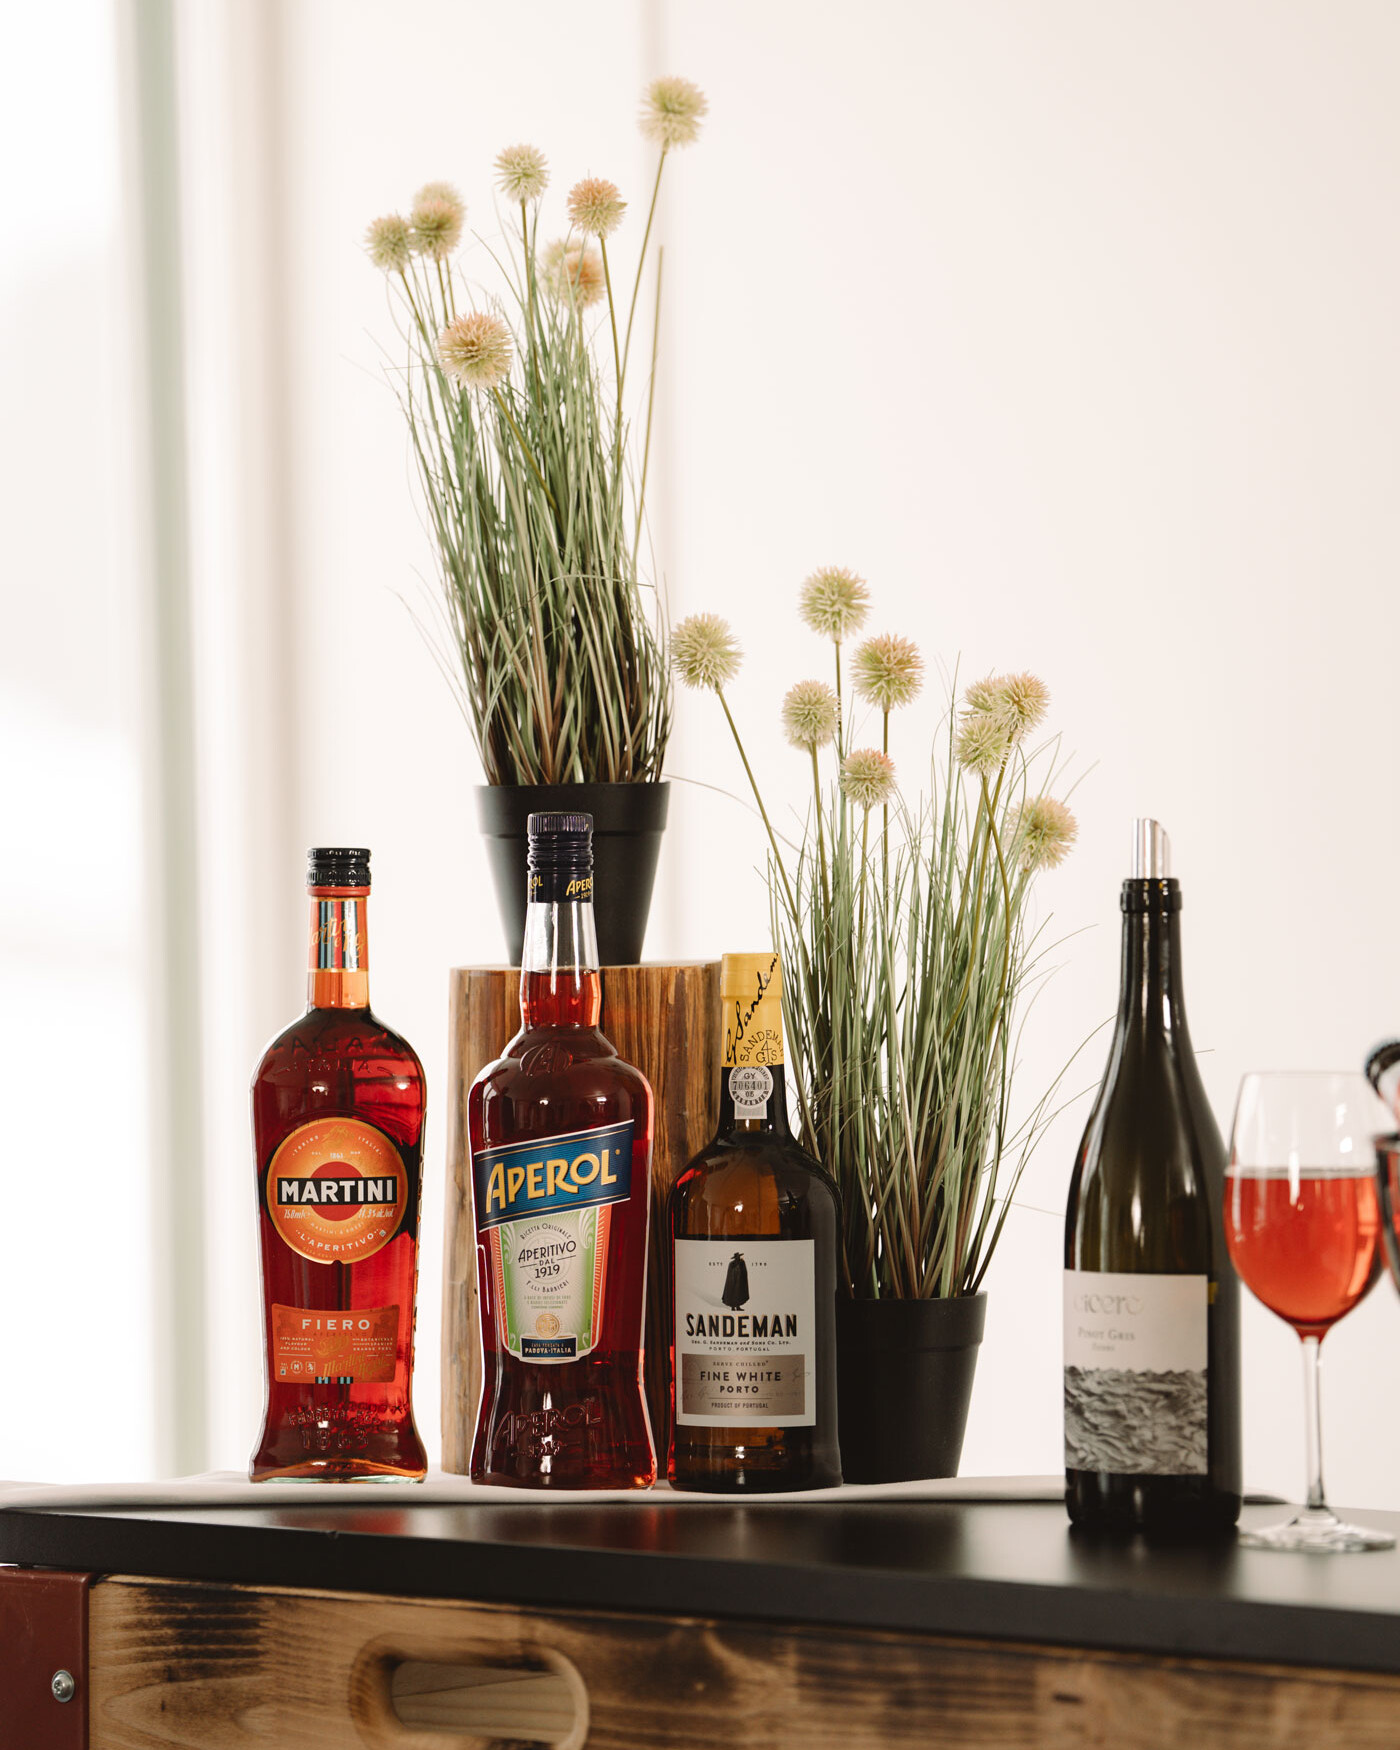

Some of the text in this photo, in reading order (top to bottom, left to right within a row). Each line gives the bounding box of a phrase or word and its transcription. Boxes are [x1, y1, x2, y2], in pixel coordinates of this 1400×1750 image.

[281, 1179, 393, 1203] MARTINI
[485, 1149, 617, 1214] APEROL
[517, 1240, 577, 1263] APERITIVO
[535, 1264, 560, 1279] 1919
[301, 1319, 371, 1330] FIERO
[686, 1313, 797, 1337] SANDEMAN
[700, 1371, 782, 1382] FINE WHITE
